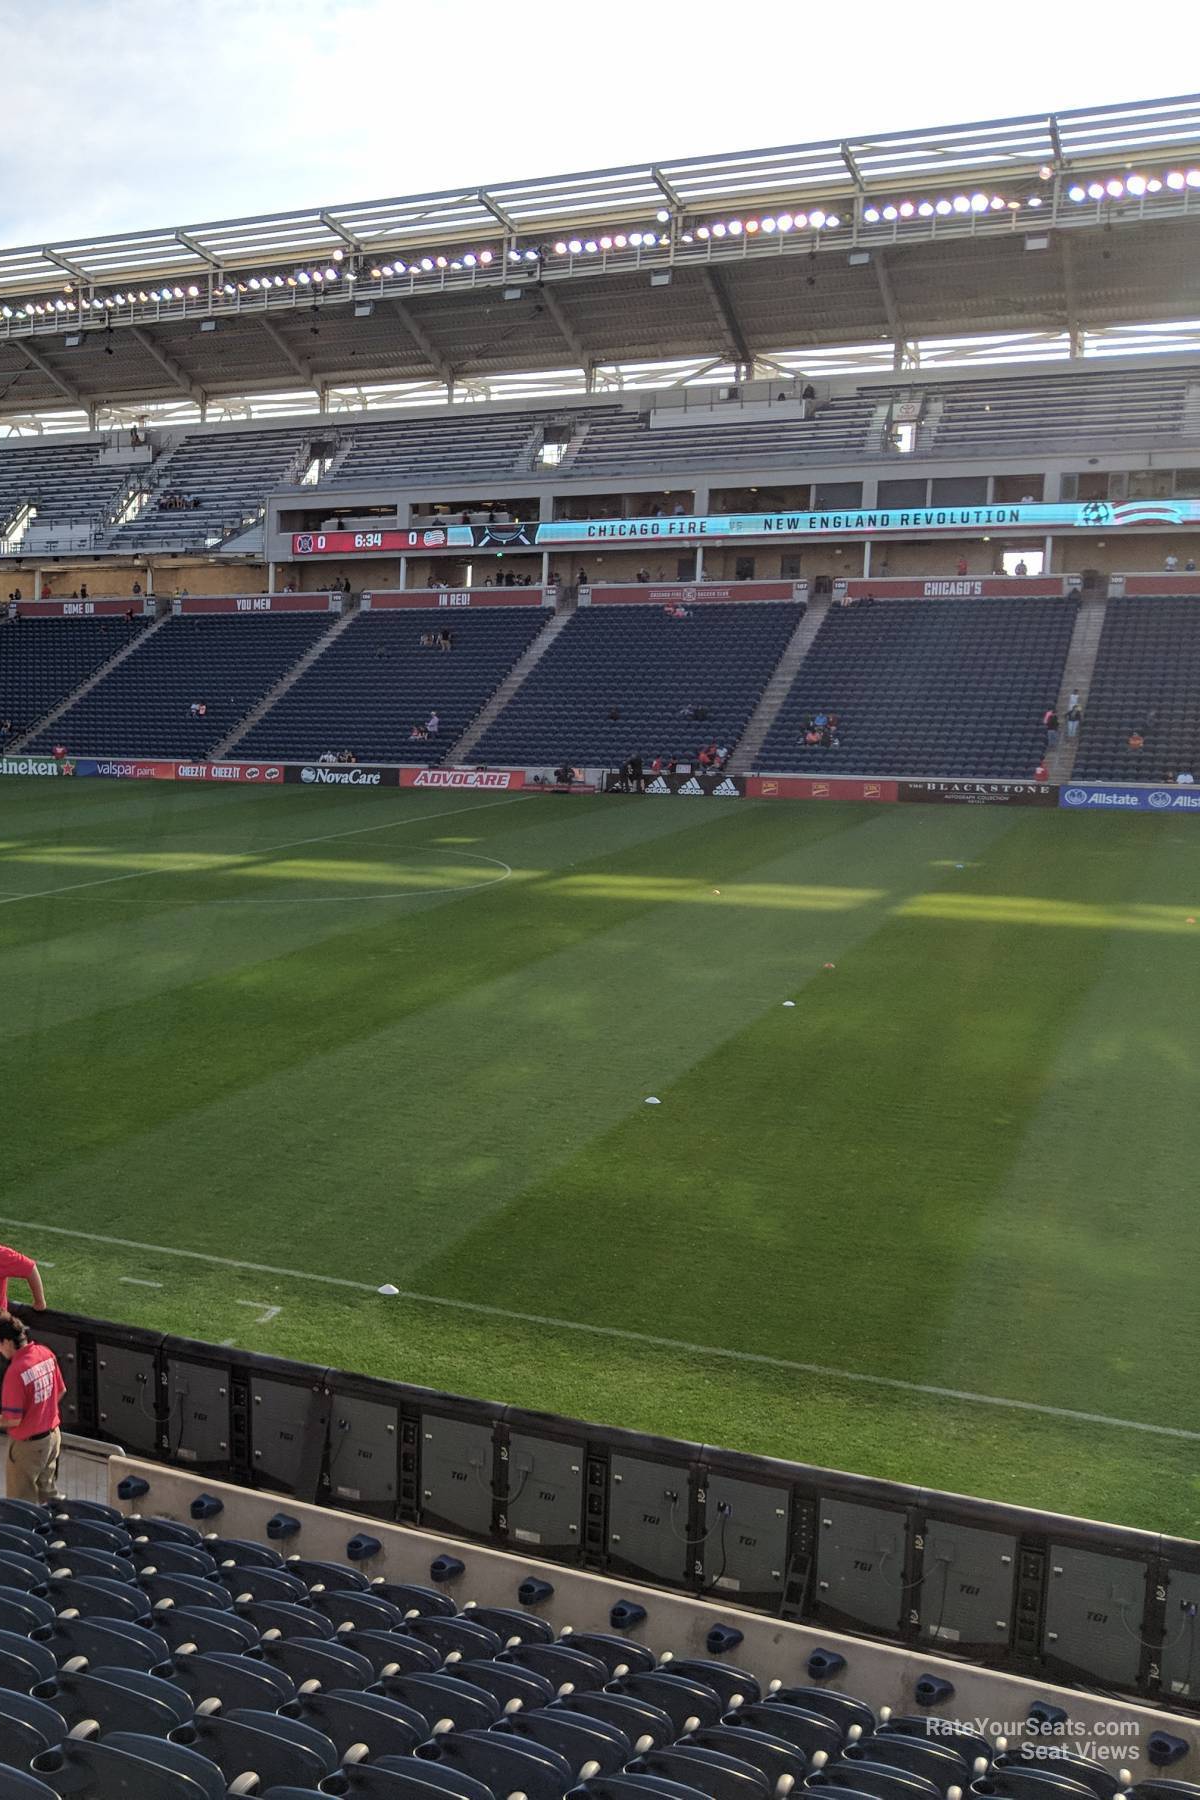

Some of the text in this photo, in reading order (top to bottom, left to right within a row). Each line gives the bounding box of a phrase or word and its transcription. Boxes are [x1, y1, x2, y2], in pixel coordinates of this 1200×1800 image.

[588, 521, 660, 537] CHICAGO
[669, 520, 707, 534] FIRE
[764, 517, 799, 531] NEW
[809, 513, 889, 529] ENGLAND
[900, 510, 1020, 525] REVOLUTION
[317, 536, 326, 549] 0
[354, 533, 382, 547] 6:34
[408, 532, 417, 545] 0
[924, 581, 982, 597] CHICAGO'S
[237, 599, 271, 611] YOU MEN
[439, 594, 471, 606] IN RED!
[63, 603, 95, 615] COME ON
[97, 761, 137, 778] valspar
[316, 768, 381, 786] NovaCare
[413, 770, 511, 789] ADVOCARE
[677, 787, 705, 795] adidas
[927, 782, 1050, 794] BLACKSTONE
[1088, 793, 1140, 806] Allstate
